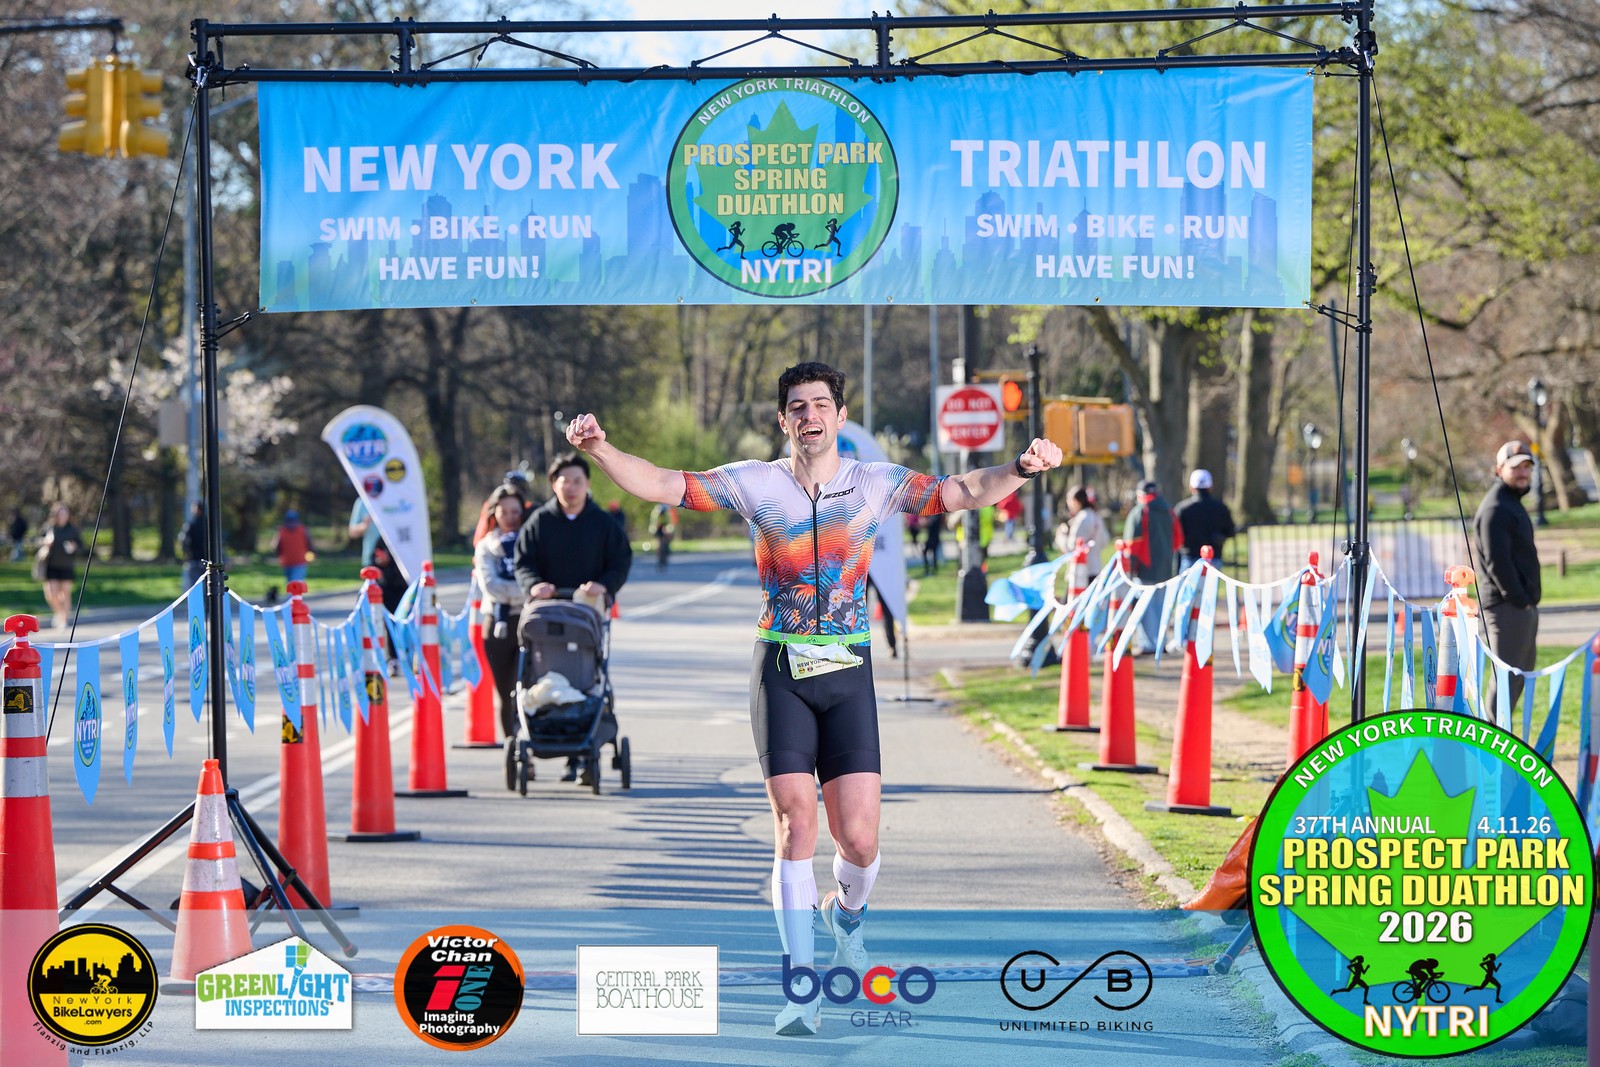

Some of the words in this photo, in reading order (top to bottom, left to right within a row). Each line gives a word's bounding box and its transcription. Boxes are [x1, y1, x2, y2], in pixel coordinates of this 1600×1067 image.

[698, 94, 732, 125] NEW
[733, 78, 778, 98] YORK
[783, 78, 871, 124] TRIATHLON
[684, 142, 812, 166] PROSPECT
[818, 142, 884, 164] PARK
[950, 140, 1266, 189] TRIATHLON
[304, 144, 438, 193] NEW
[451, 143, 620, 191] YORK
[734, 168, 826, 190] SPRING
[717, 192, 844, 216] DUATHLON
[320, 216, 400, 241] SWIM
[430, 215, 500, 240] BIKE
[528, 214, 592, 239] RUN
[976, 214, 1058, 238] SWIM
[1086, 214, 1156, 239] BIKE
[1184, 215, 1248, 240] RUN
[379, 256, 458, 281] HAVE
[467, 256, 540, 280] FUN!
[740, 258, 832, 284] NYTRI
[1036, 254, 1113, 279] HAVE
[1123, 254, 1195, 280] FUN!
[968, 398, 992, 410] NOT
[952, 427, 990, 440] ENTER
[76, 718, 100, 742] NYTRI
